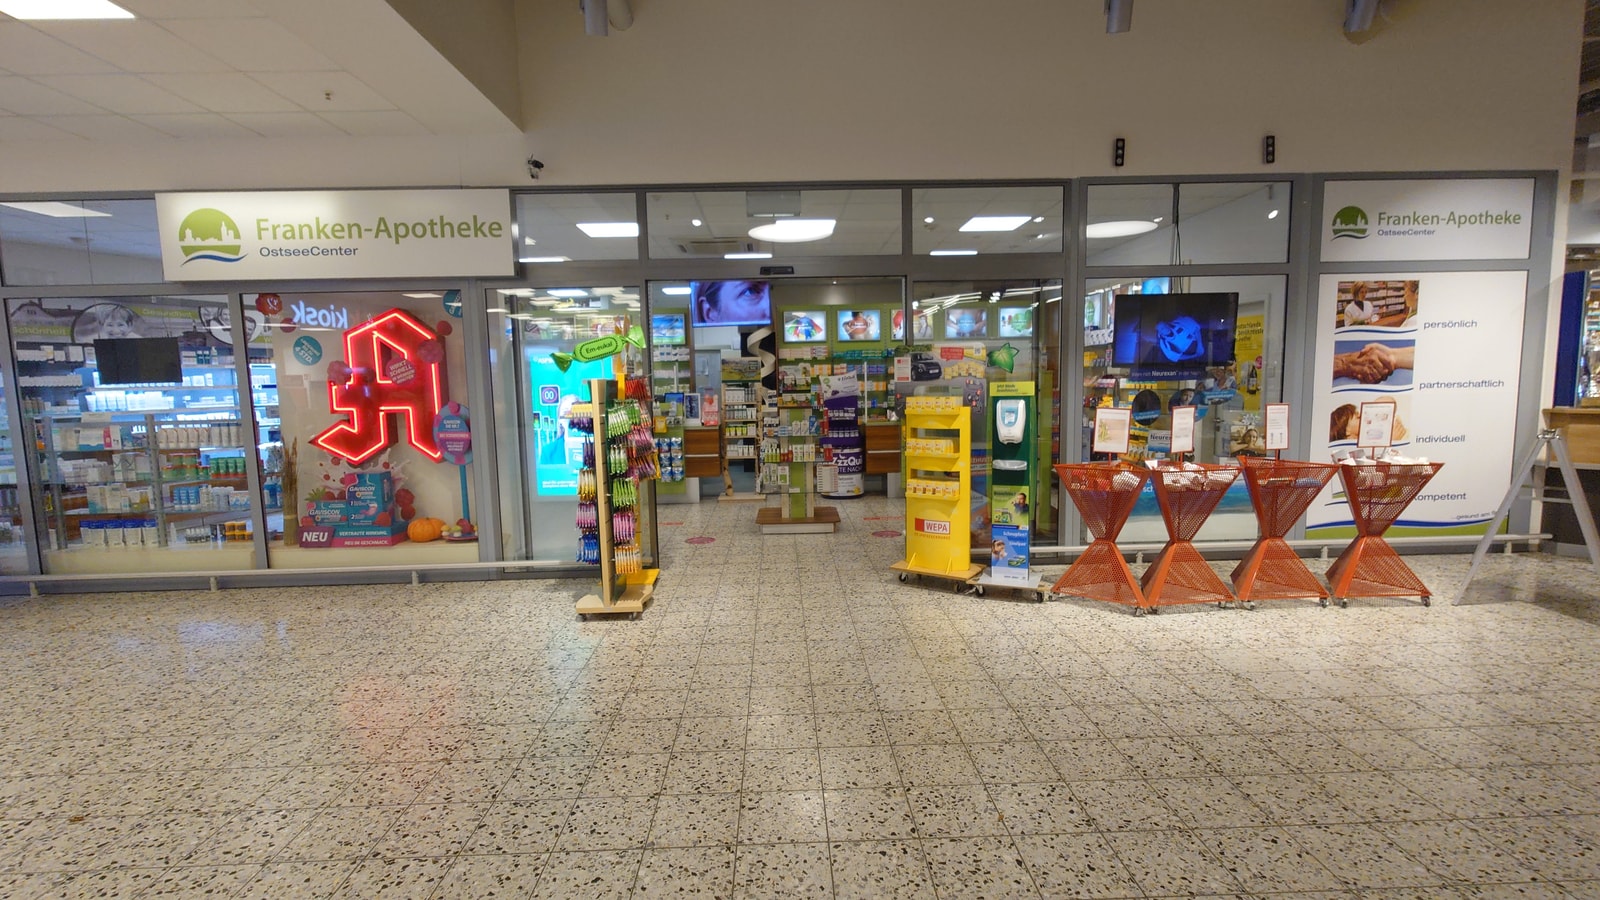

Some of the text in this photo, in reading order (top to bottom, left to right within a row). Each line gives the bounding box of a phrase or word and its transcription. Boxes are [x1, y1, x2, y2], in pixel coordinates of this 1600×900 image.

[1377, 210, 1522, 228] Franken-Apotheke
[256, 215, 503, 245] Franken-Apotheke
[1377, 228, 1436, 237] OstseeCenter
[259, 246, 359, 257] OstseeCenter
[143, 308, 193, 318] Gesundheit
[1423, 320, 1478, 330] persönlich
[585, 342, 614, 354] Em-eukal
[1419, 379, 1504, 390] partnerschaftlich
[1415, 435, 1466, 444] individuell
[926, 522, 948, 532] WEPA
[302, 532, 328, 542] NEU
